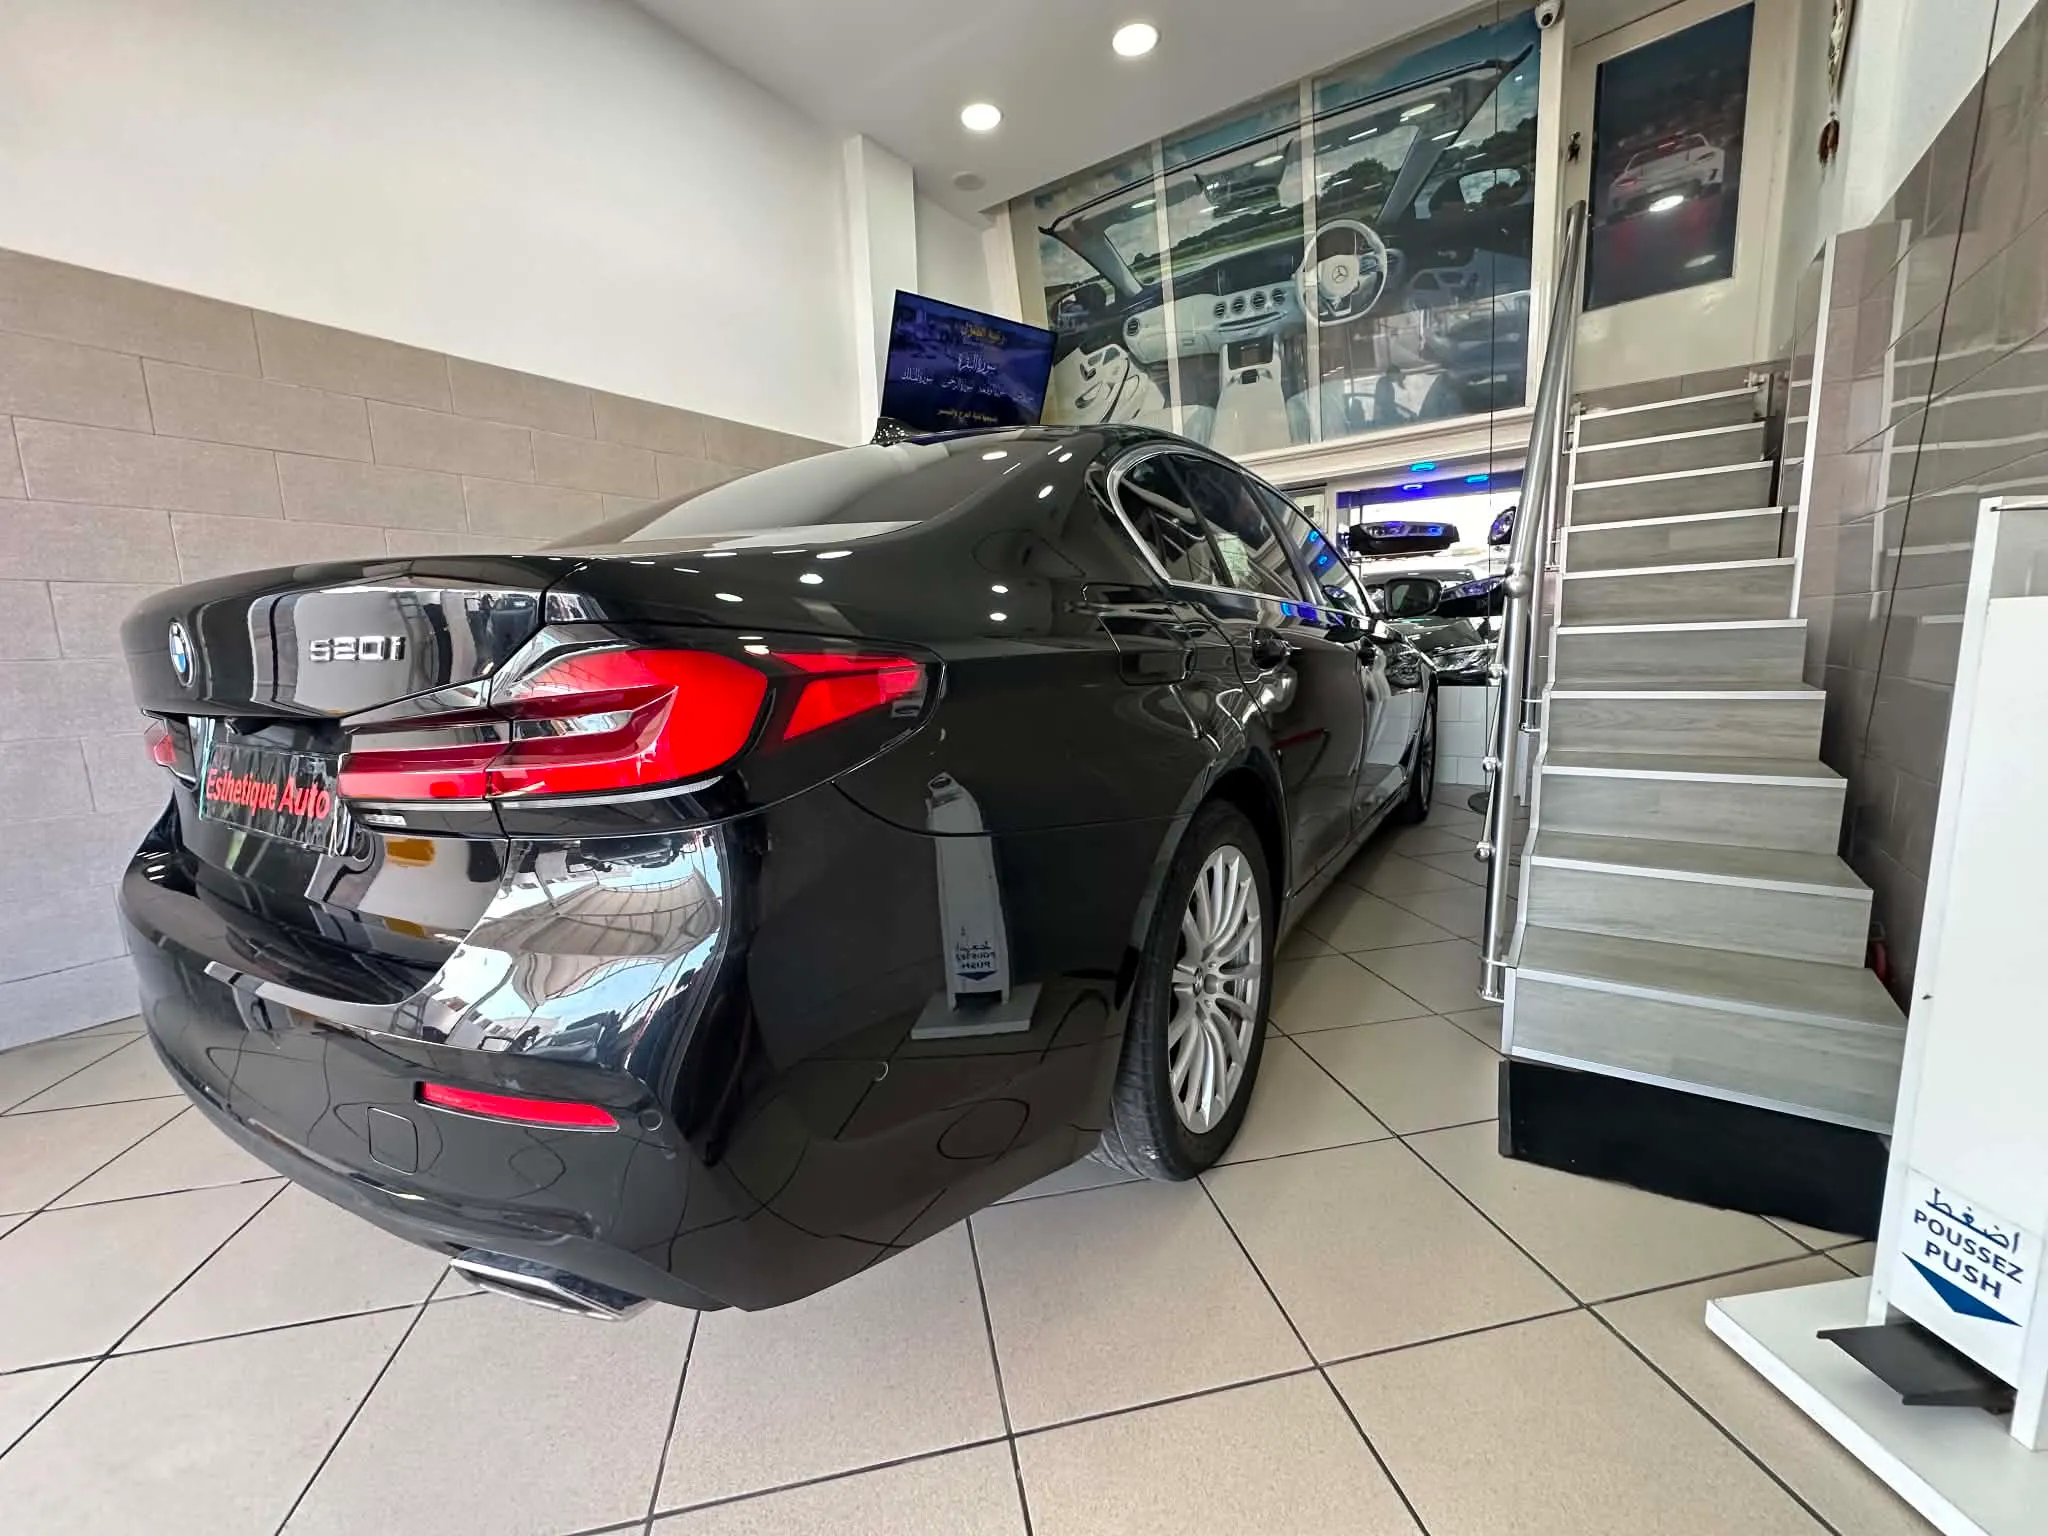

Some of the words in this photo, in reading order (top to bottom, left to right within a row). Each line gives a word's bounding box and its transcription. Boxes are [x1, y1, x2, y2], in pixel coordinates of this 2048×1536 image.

[206, 768, 277, 817] Esthetique
[277, 776, 331, 820] Auto
[1914, 1208, 2024, 1285] POUSSEZ
[1925, 1187, 2020, 1254] اضغط
[1925, 1239, 2003, 1300] PUSH
